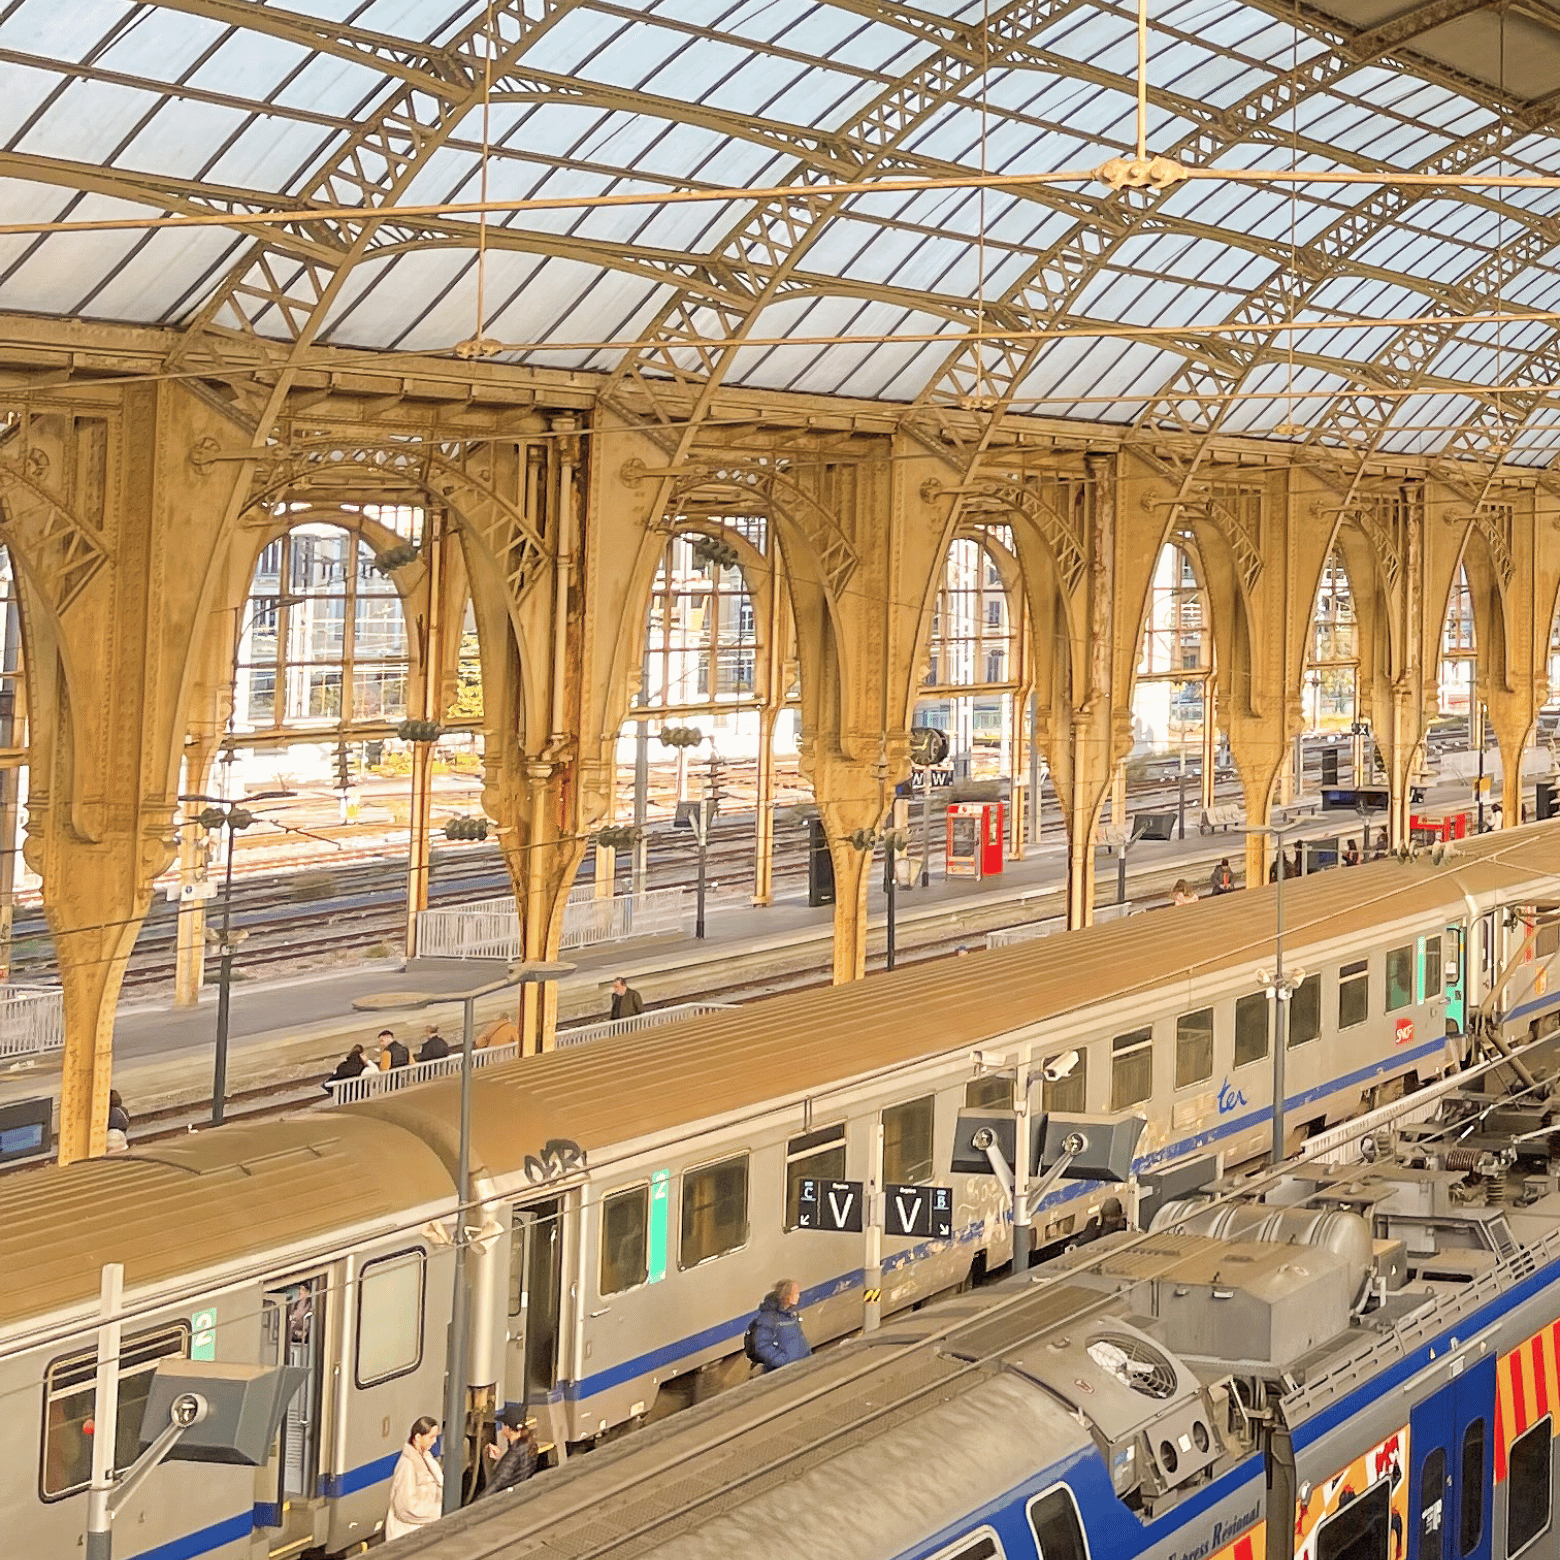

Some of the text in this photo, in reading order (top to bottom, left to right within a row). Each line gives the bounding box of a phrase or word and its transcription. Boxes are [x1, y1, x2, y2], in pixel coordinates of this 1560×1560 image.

[932, 772, 948, 786] W
[804, 1186, 814, 1199] C
[937, 1195, 946, 1208] B
[828, 1191, 854, 1228] V
[895, 1195, 922, 1233] V
[195, 1313, 212, 1346] 2
[1212, 1499, 1260, 1550] Régional
